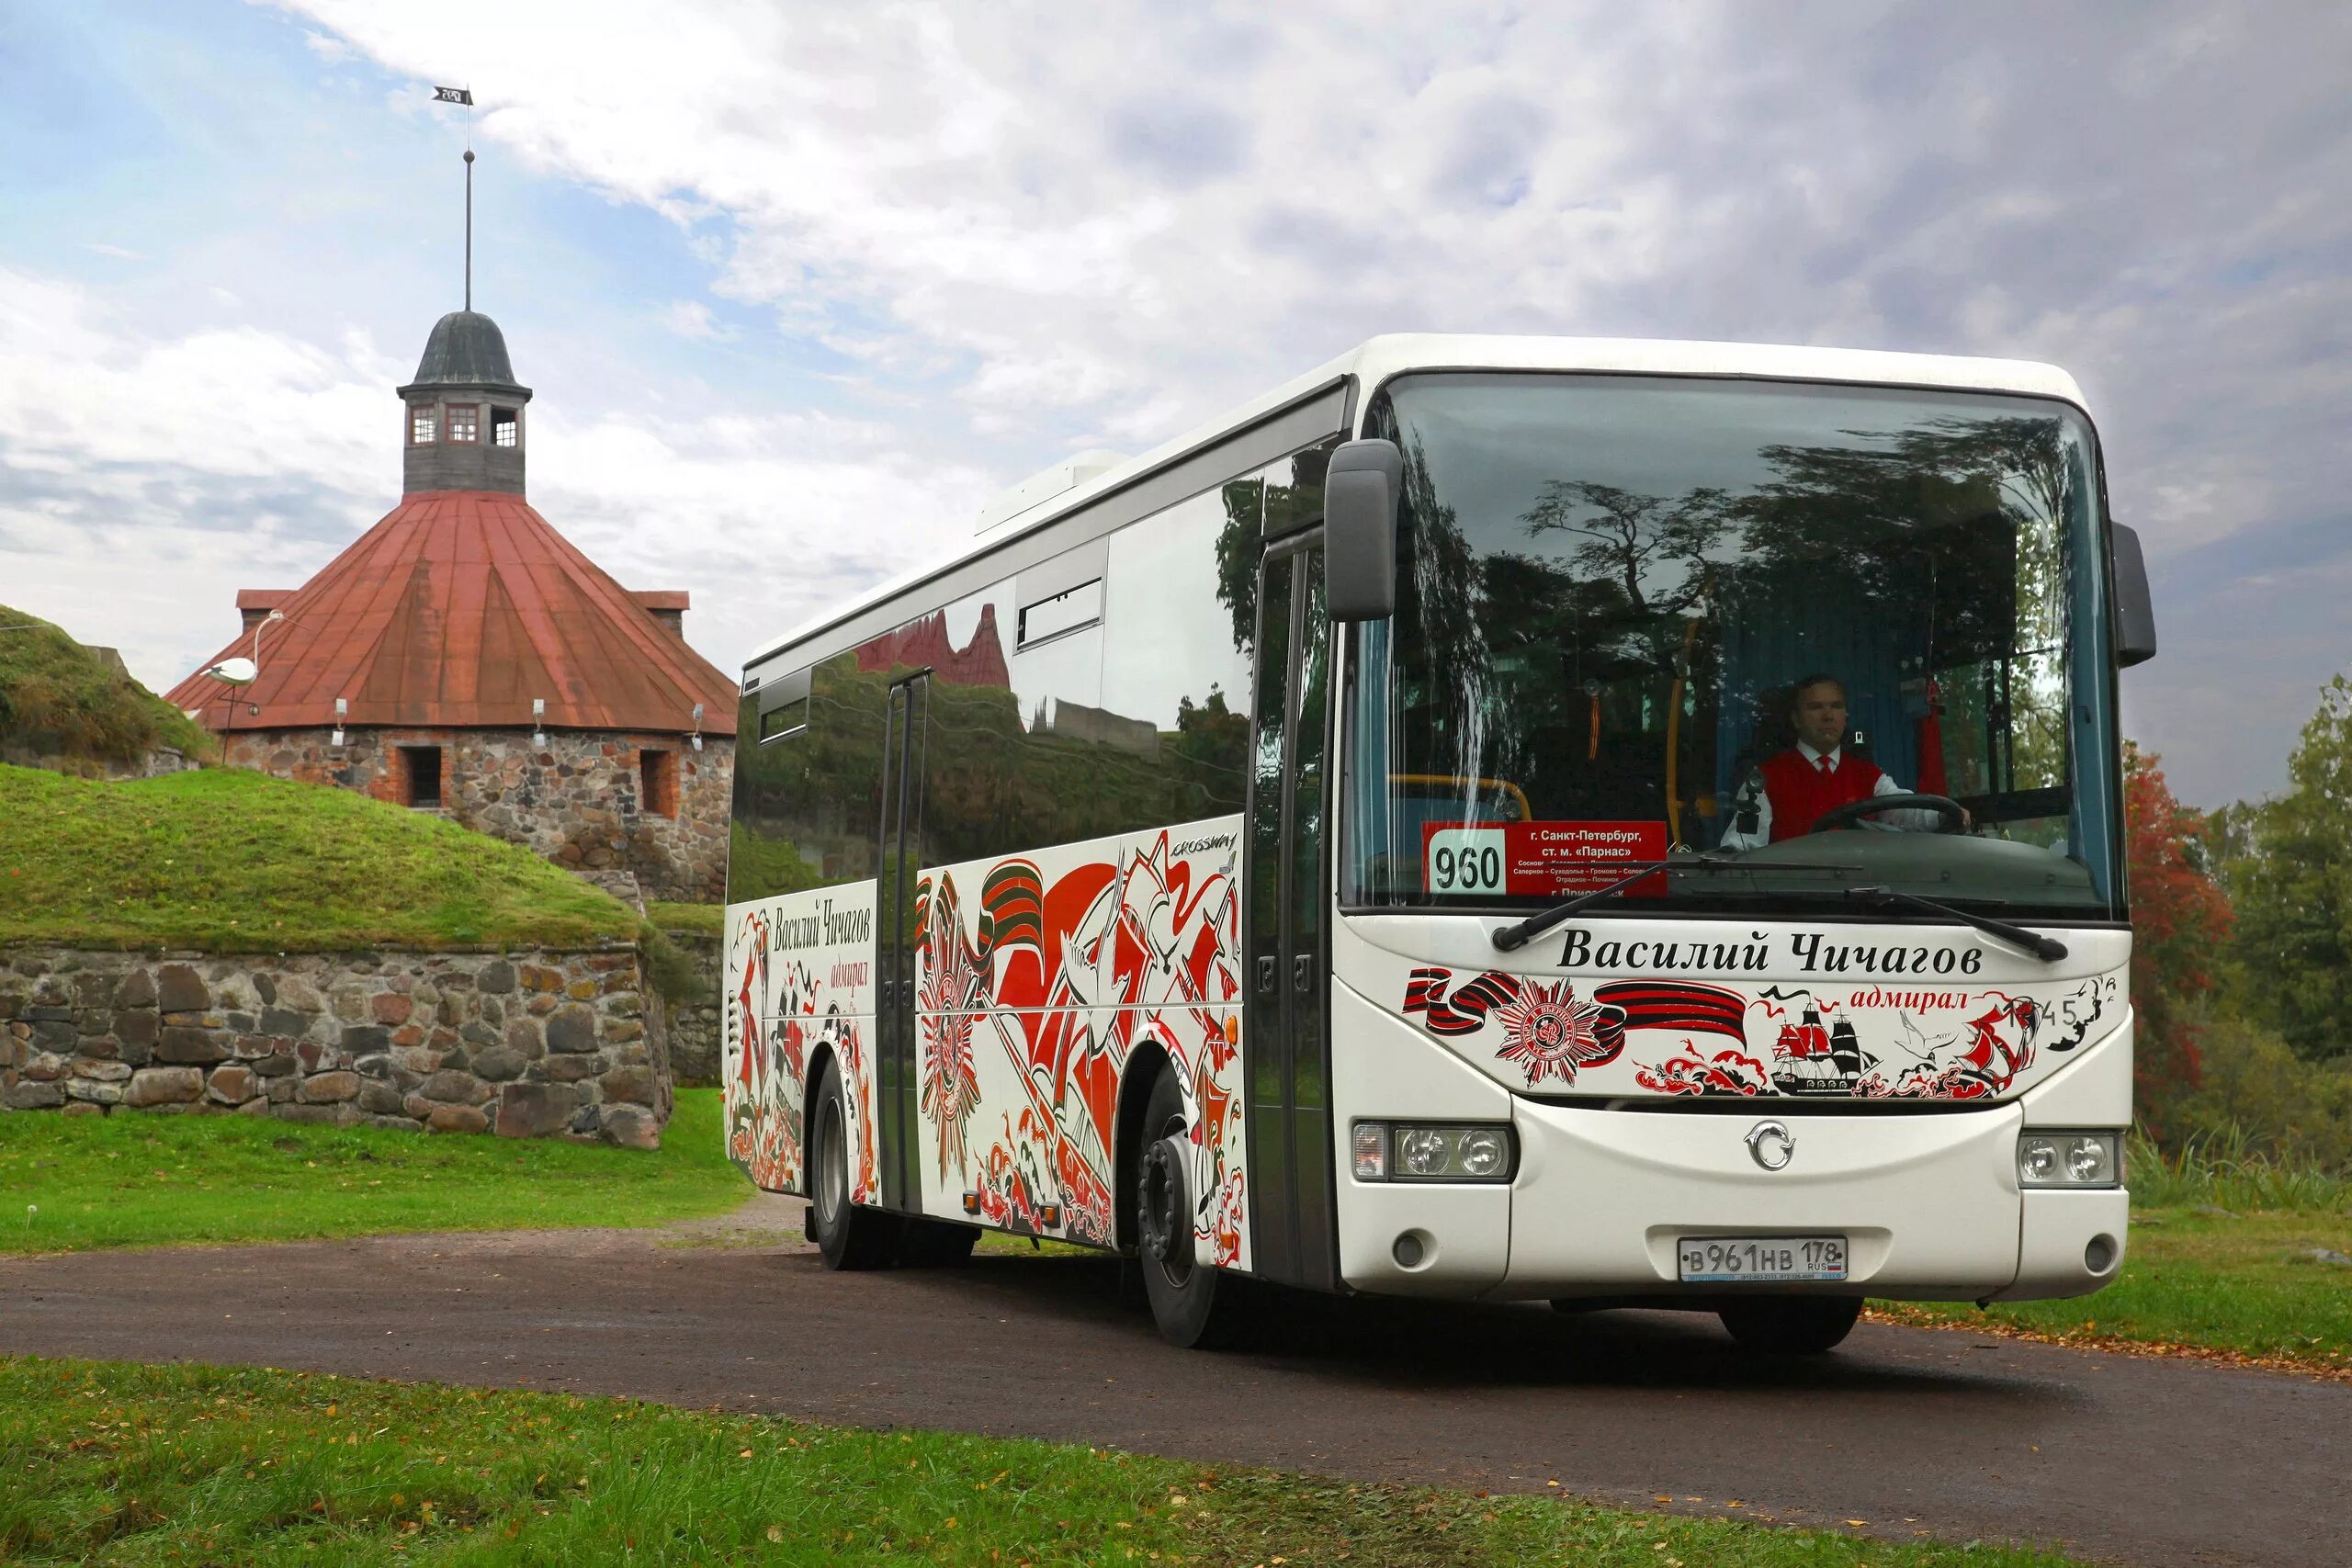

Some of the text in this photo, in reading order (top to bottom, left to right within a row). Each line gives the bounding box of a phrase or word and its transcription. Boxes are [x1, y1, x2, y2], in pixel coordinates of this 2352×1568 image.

[1170, 831, 1238, 856] CROSSWAY
[1541, 829, 1642, 843] Санкт-Петербург,
[1542, 848, 1557, 857] ст.
[1576, 845, 1632, 858] «Парнас»
[1435, 846, 1499, 889] 960
[775, 898, 871, 952] Василий Чичагов
[1556, 929, 1983, 975] Василий Чичагов
[831, 953, 869, 998] адмирал
[1849, 984, 1968, 1016] адмирал
[1801, 1241, 1838, 1263] 178
